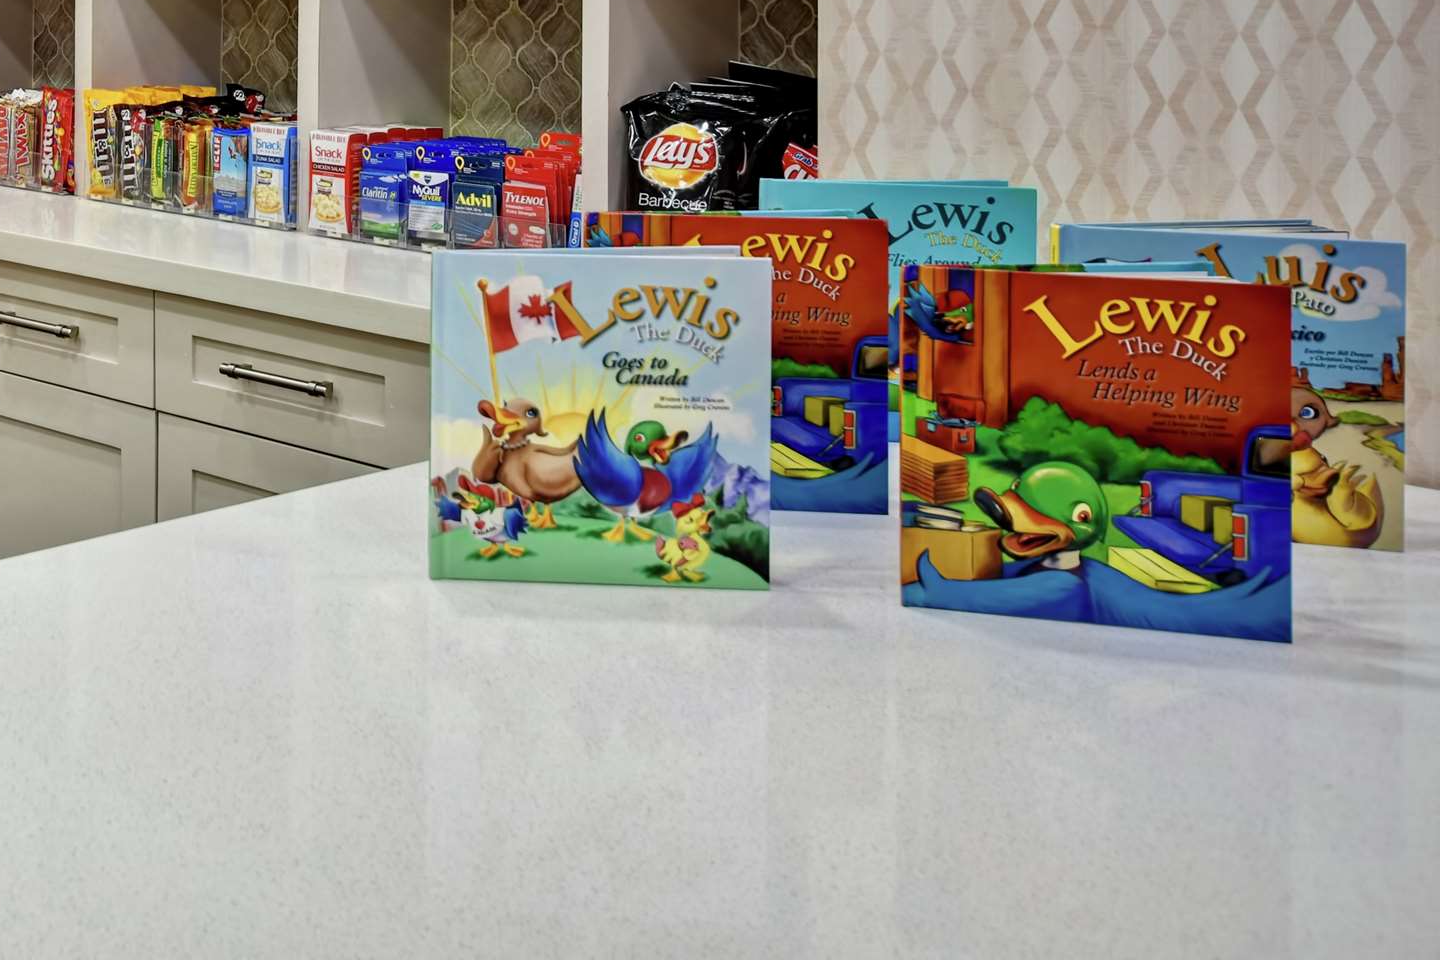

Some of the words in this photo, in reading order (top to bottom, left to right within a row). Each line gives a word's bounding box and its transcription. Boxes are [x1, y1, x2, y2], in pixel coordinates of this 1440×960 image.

[42, 99, 58, 180] Skittles
[315, 146, 343, 160] Snack
[643, 136, 716, 170] Lay's
[362, 187, 388, 199] Claritin
[412, 184, 441, 198] NyQuil
[456, 191, 492, 209] Advil
[504, 191, 545, 207] TYLENOL
[638, 192, 708, 213] Barbecue
[741, 229, 856, 282] ewis
[927, 230, 957, 248] The
[961, 232, 1004, 263] Duck
[798, 267, 841, 301] Duck
[775, 292, 787, 304] a
[1292, 290, 1337, 317] Pato
[547, 276, 740, 349] Lewis
[807, 306, 851, 326] Wing
[1023, 294, 1246, 360] Lewis
[630, 322, 671, 343] The
[676, 326, 725, 364] Duck
[602, 350, 644, 369] Goes
[650, 356, 669, 369] to
[1077, 358, 1139, 381] Lends
[1144, 368, 1157, 381] a
[1118, 336, 1164, 356] The
[1170, 339, 1228, 382] Duck
[615, 367, 690, 387] Canada
[1092, 381, 1175, 408] Helping
[1184, 386, 1241, 413] Wing
